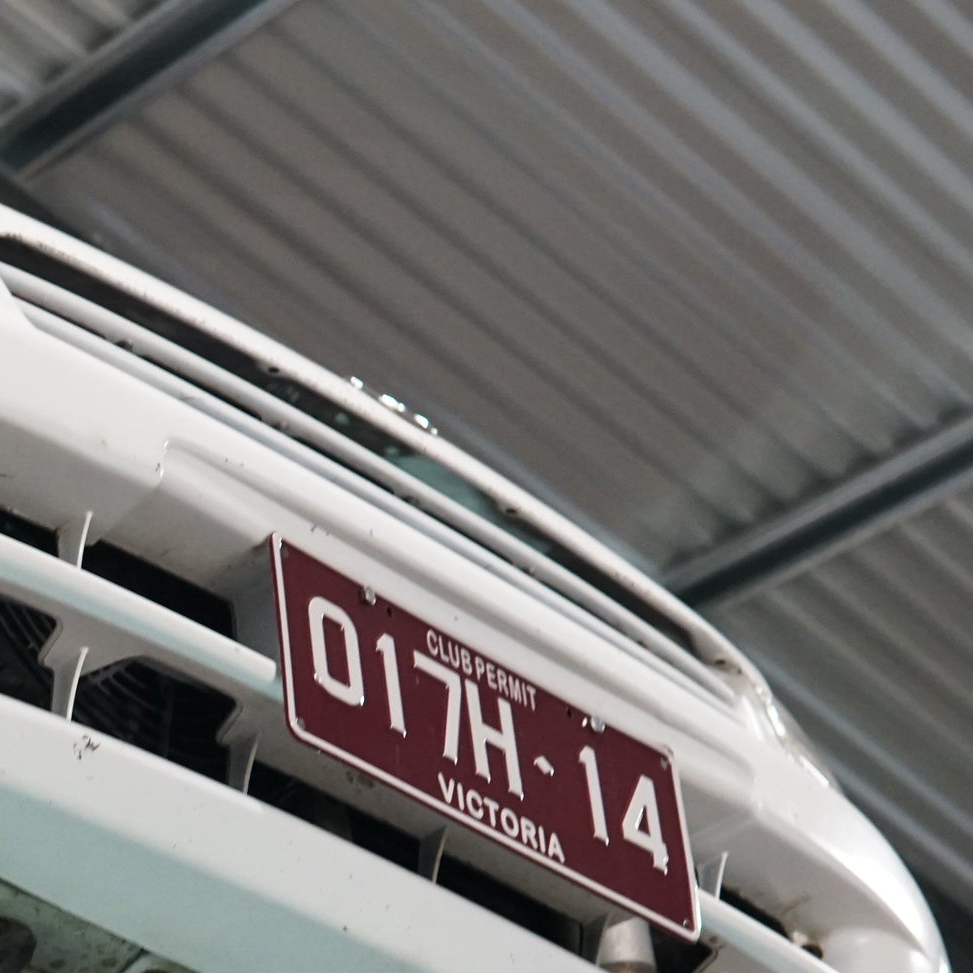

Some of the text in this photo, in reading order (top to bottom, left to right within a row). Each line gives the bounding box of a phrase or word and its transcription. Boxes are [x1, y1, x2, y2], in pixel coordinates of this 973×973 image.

[427, 630, 537, 711] CLUB PERMIT
[438, 772, 565, 864] VICTORIA
